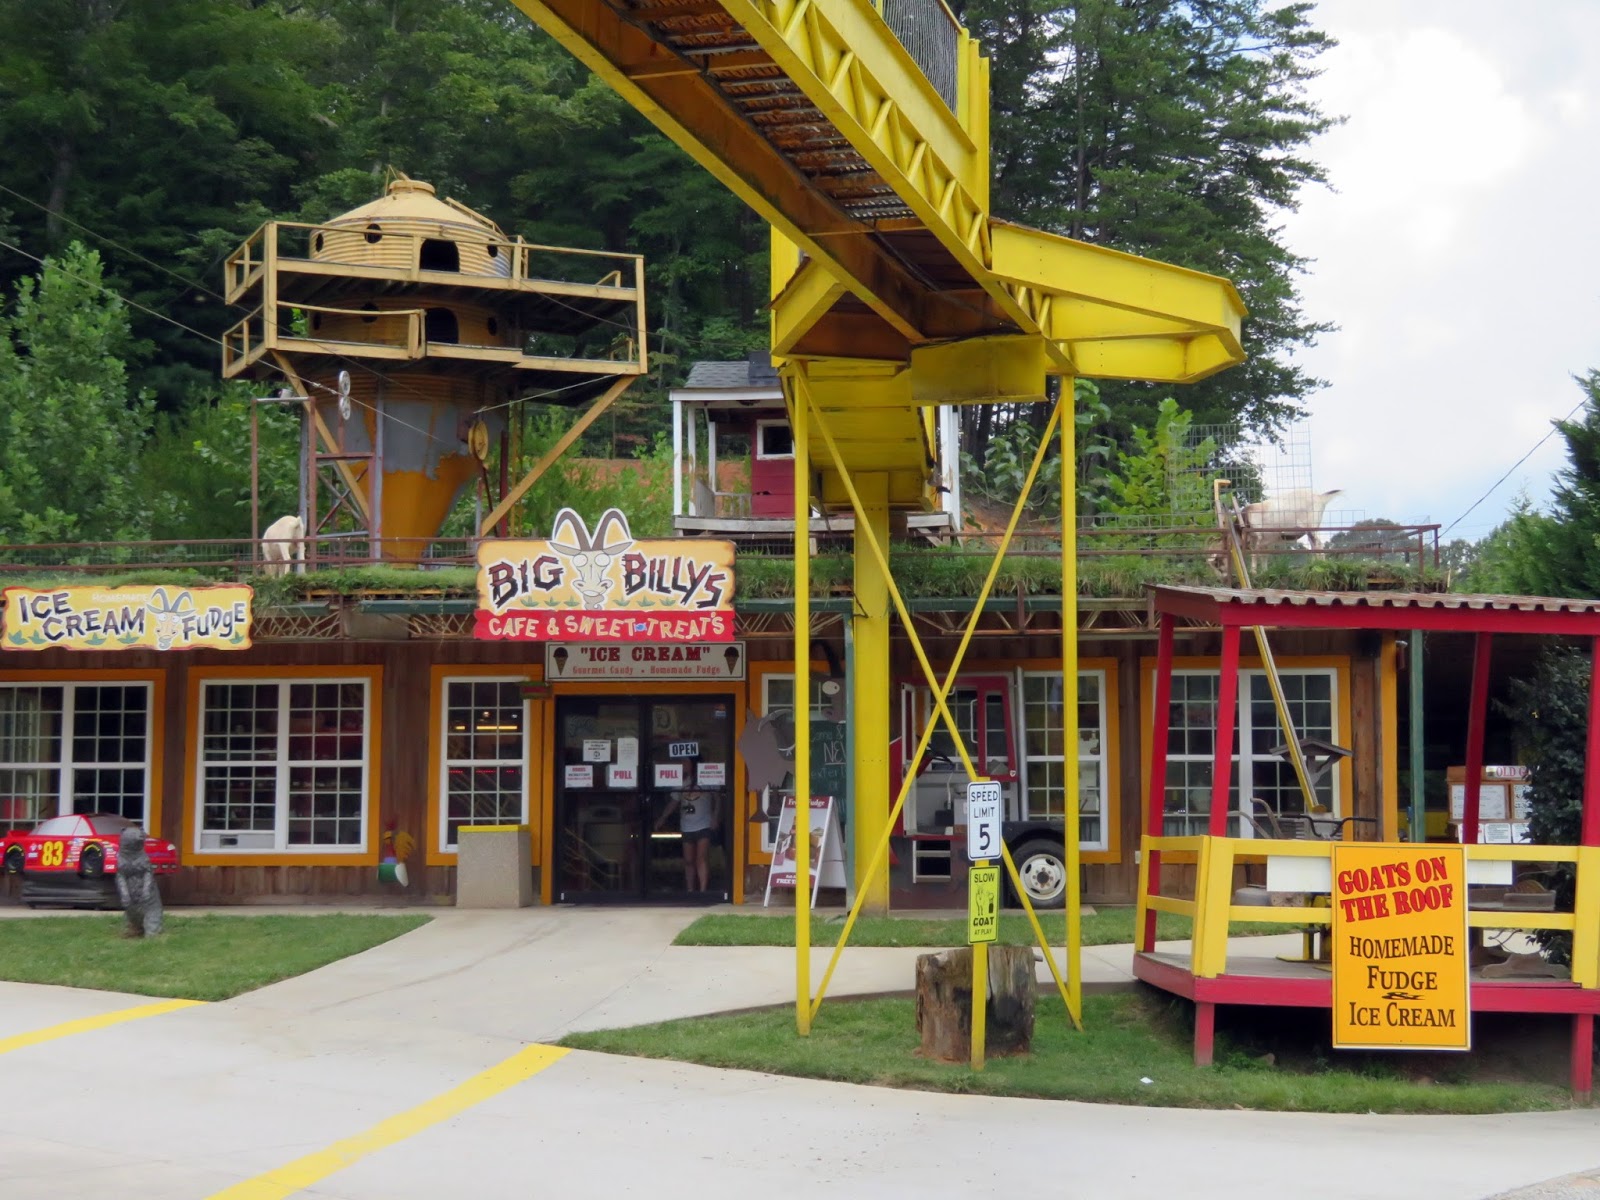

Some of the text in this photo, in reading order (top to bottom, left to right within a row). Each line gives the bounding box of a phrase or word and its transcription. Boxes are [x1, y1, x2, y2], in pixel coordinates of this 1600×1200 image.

[488, 555, 564, 608] BIG
[19, 593, 72, 623] ICE
[42, 607, 145, 641] CREAM
[488, 617, 538, 638] CAFE
[546, 618, 560, 636] &
[564, 615, 636, 638] SWEET
[572, 665, 721, 675] Gourmet Candy Homemade Fudge
[672, 743, 697, 756] OPEN
[613, 770, 632, 780] PULL
[659, 769, 678, 779] PULL
[1496, 766, 1516, 777] OLD
[970, 791, 998, 802] SPEED
[973, 806, 995, 818] LIMIT
[979, 823, 990, 850] 5
[42, 841, 64, 866] 83
[974, 872, 995, 883] SLOW
[1338, 856, 1448, 895] GOATS ON
[1340, 884, 1453, 923] THE ROOF
[973, 917, 994, 927] GOAT
[1350, 935, 1454, 959] HOMEMADE
[1367, 965, 1438, 990] FUDGE
[1349, 1002, 1456, 1027] ICE CREAM
